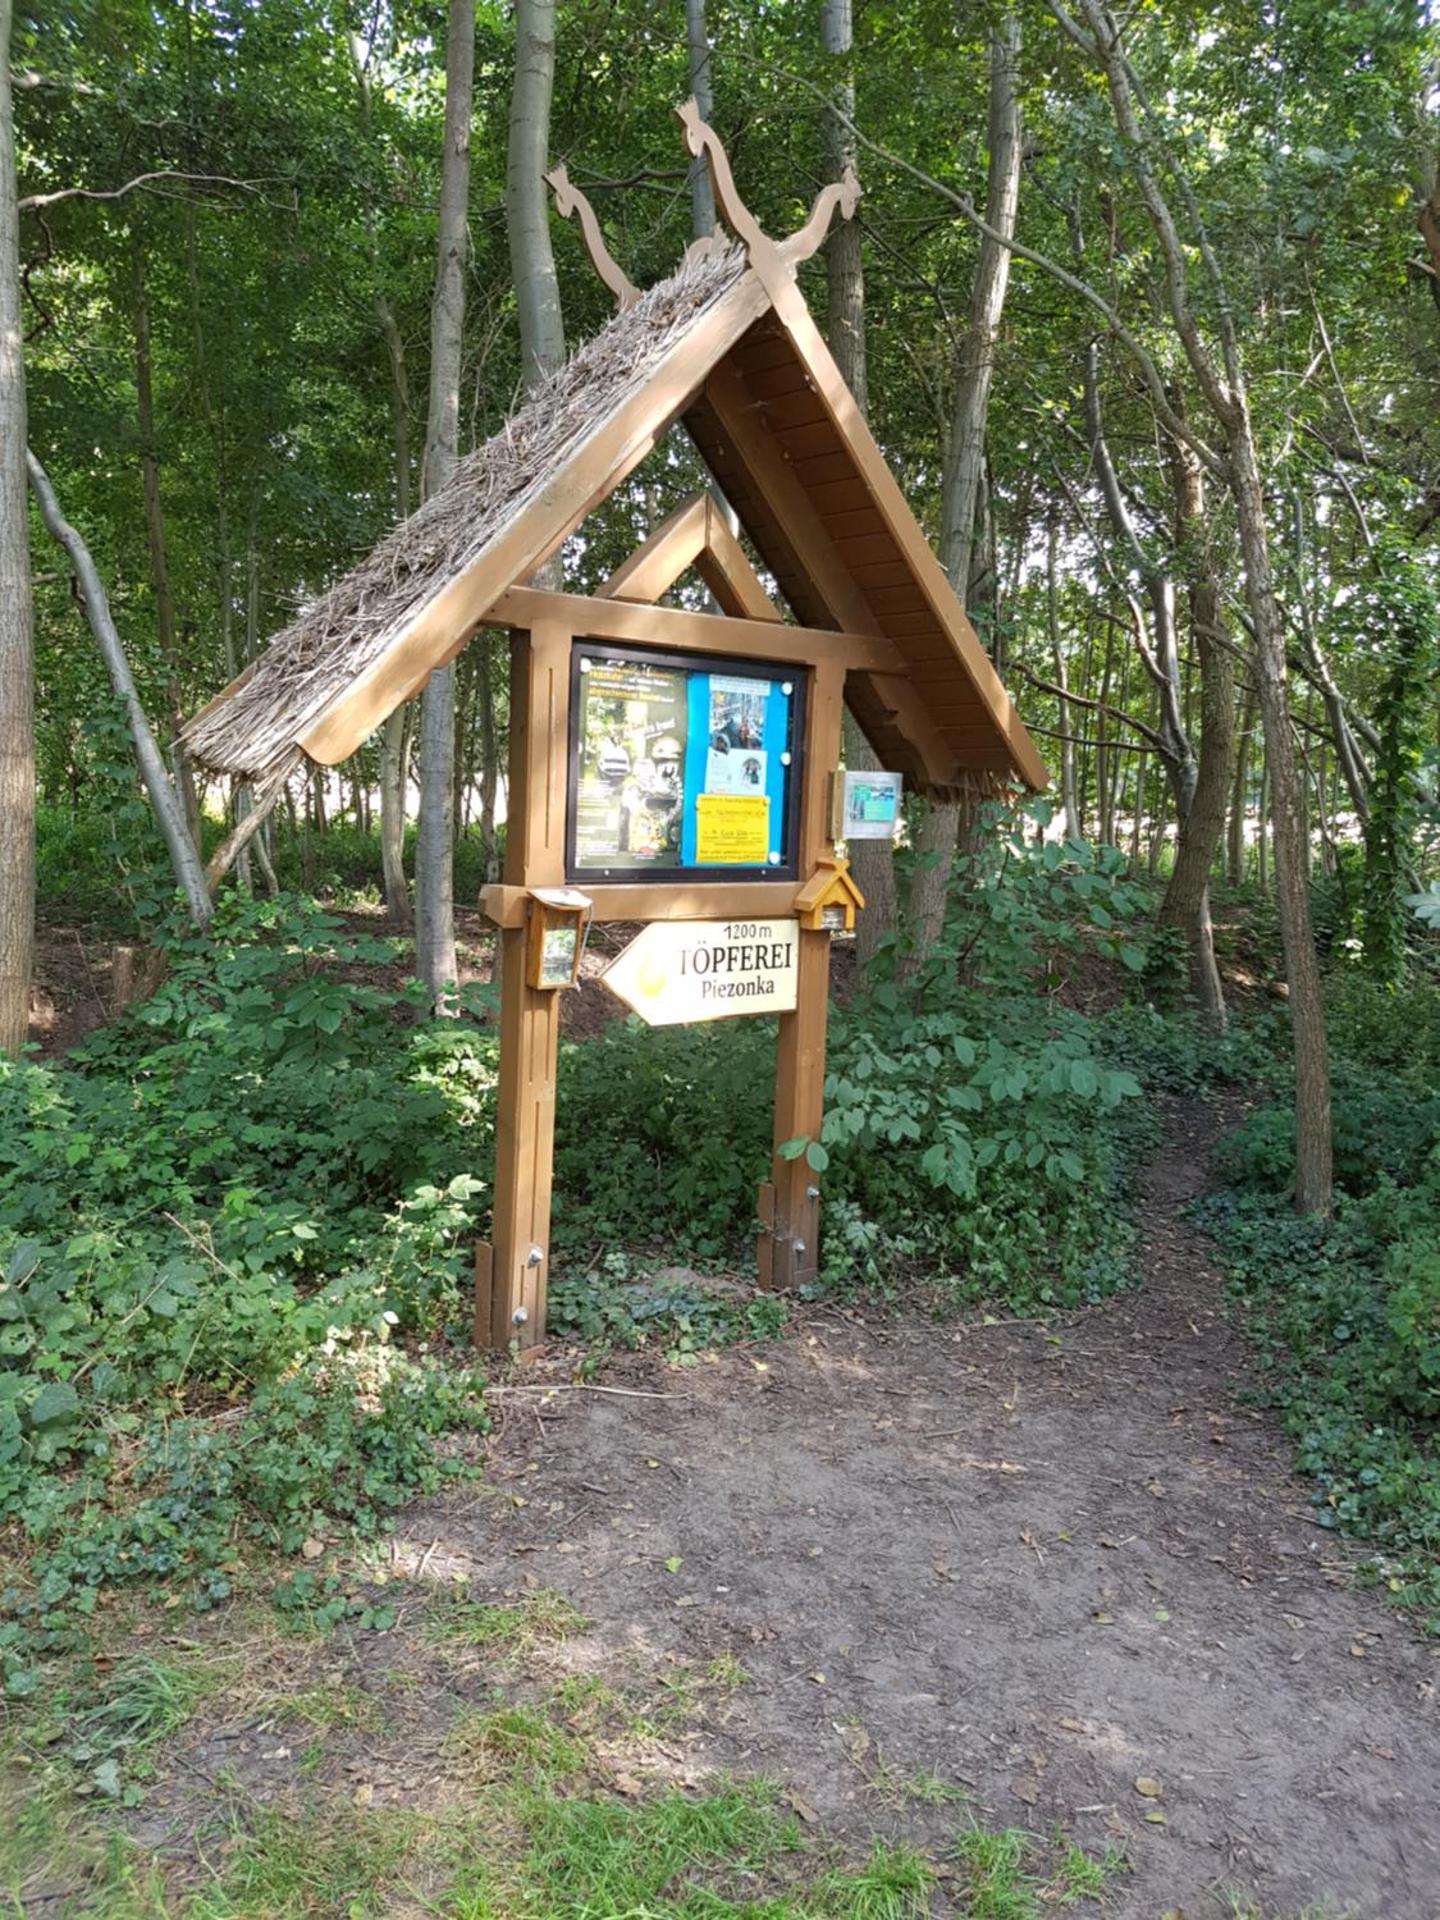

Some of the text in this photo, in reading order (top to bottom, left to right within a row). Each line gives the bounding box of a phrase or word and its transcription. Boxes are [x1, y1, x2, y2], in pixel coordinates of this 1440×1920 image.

[723, 923, 773, 940] 1200 m
[701, 974, 775, 999] Piezonka
